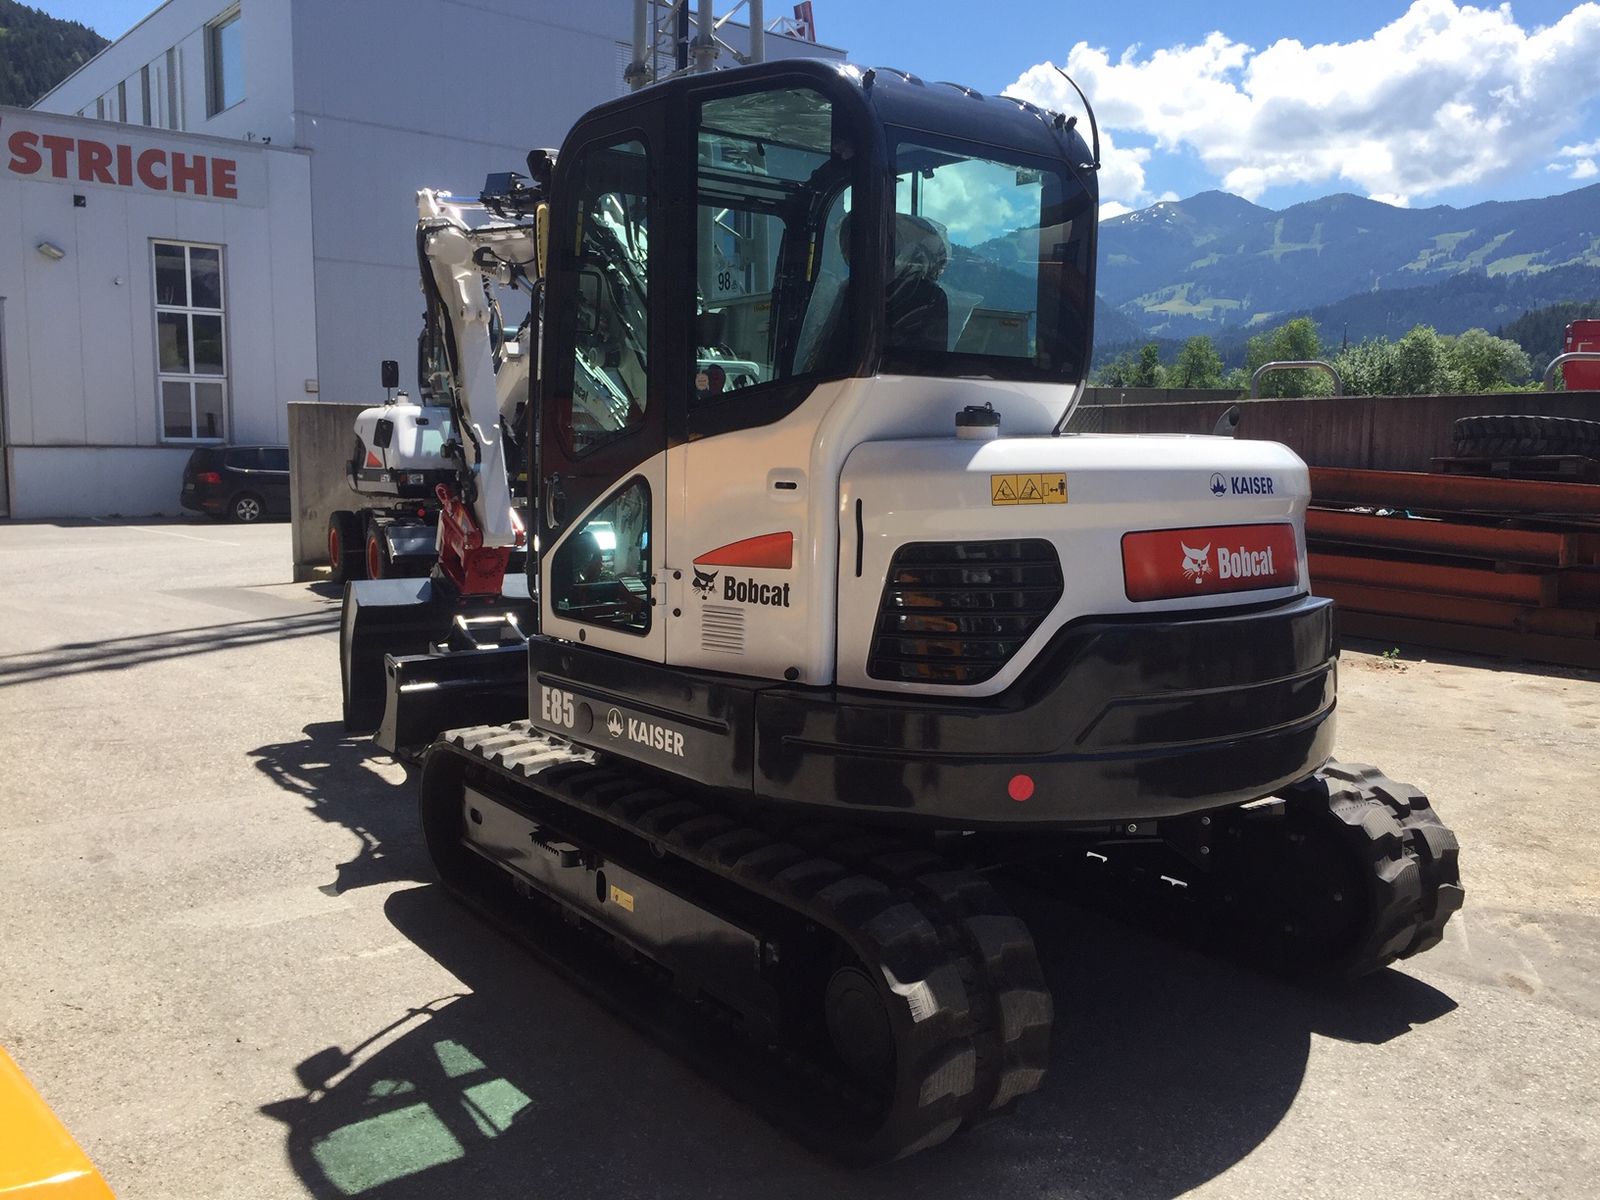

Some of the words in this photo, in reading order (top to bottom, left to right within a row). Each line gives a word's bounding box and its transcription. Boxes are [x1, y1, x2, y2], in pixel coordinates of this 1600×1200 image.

[8, 131, 238, 199] STRICHE
[718, 272, 731, 290] 98
[1231, 476, 1274, 495] KAISER
[1217, 546, 1274, 579] Bobcat
[723, 575, 790, 607] Bobcat
[541, 686, 575, 729] E85
[628, 718, 685, 757] KAISER
